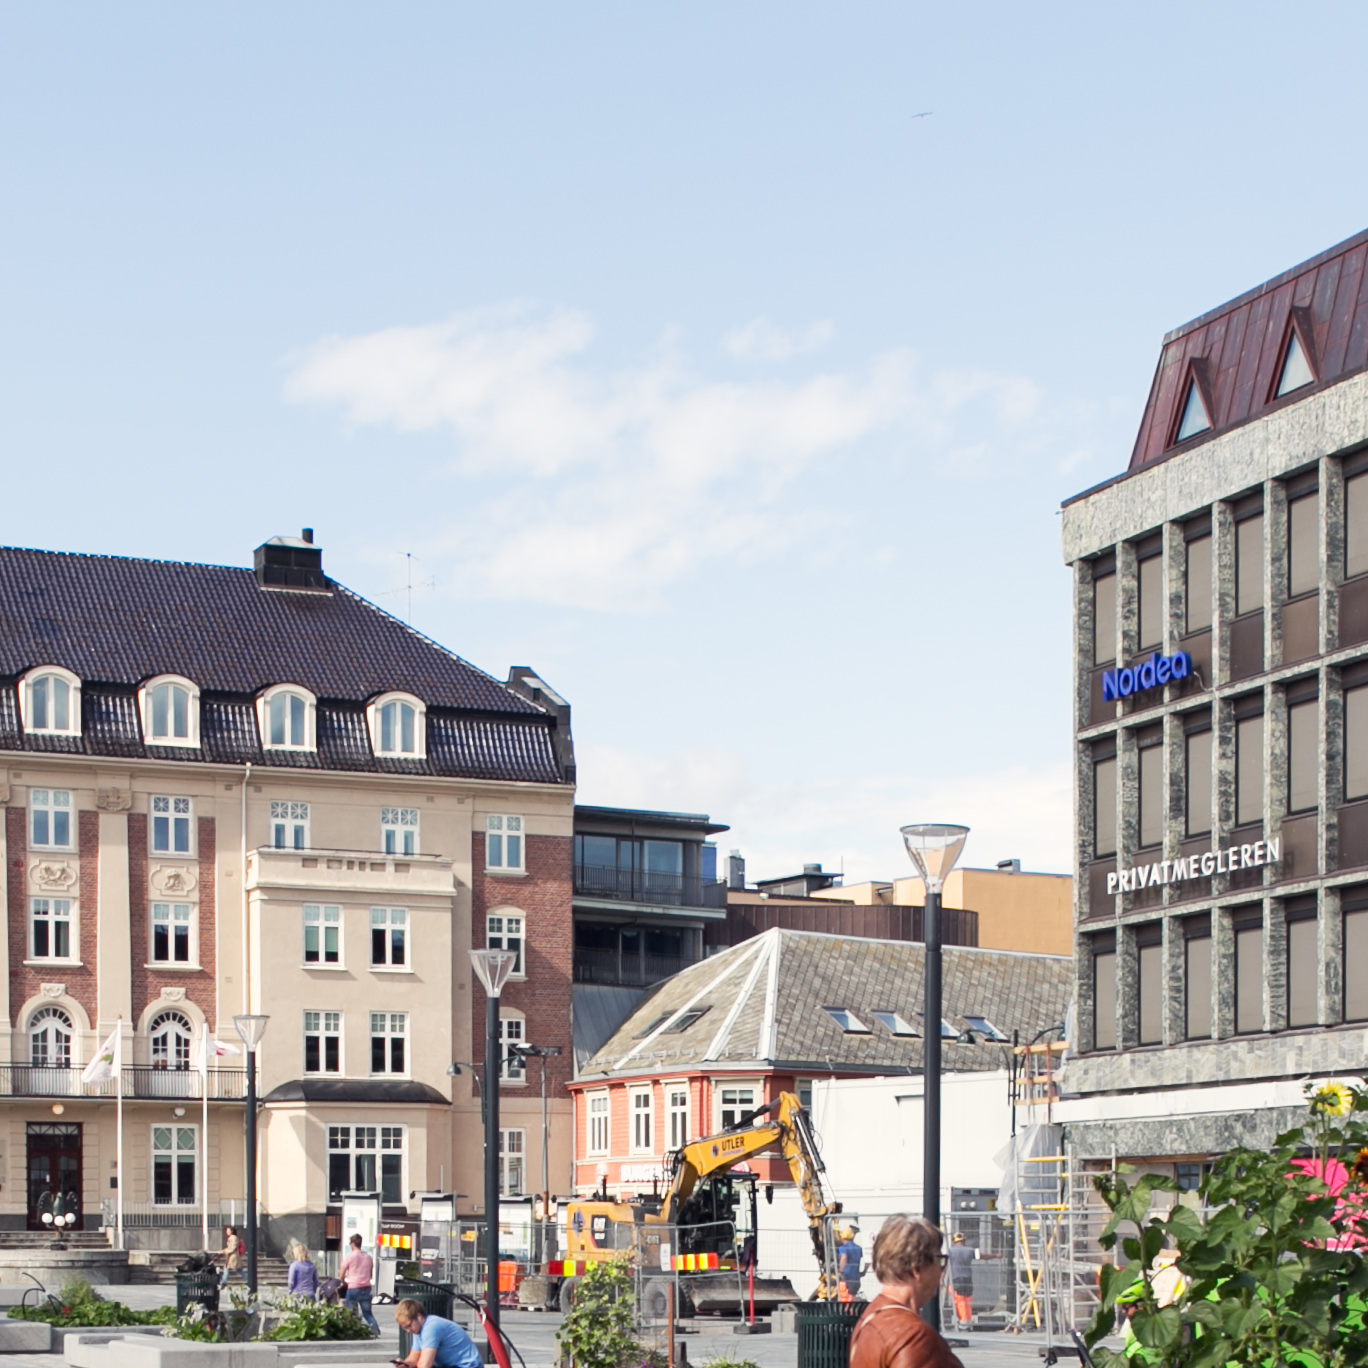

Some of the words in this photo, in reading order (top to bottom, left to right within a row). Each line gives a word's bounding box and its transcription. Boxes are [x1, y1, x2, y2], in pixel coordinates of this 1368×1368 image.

[1102, 650, 1192, 702] Nordea
[1106, 837, 1280, 895] PRIVATMEGLEREN
[721, 1136, 745, 1151] UTLER
